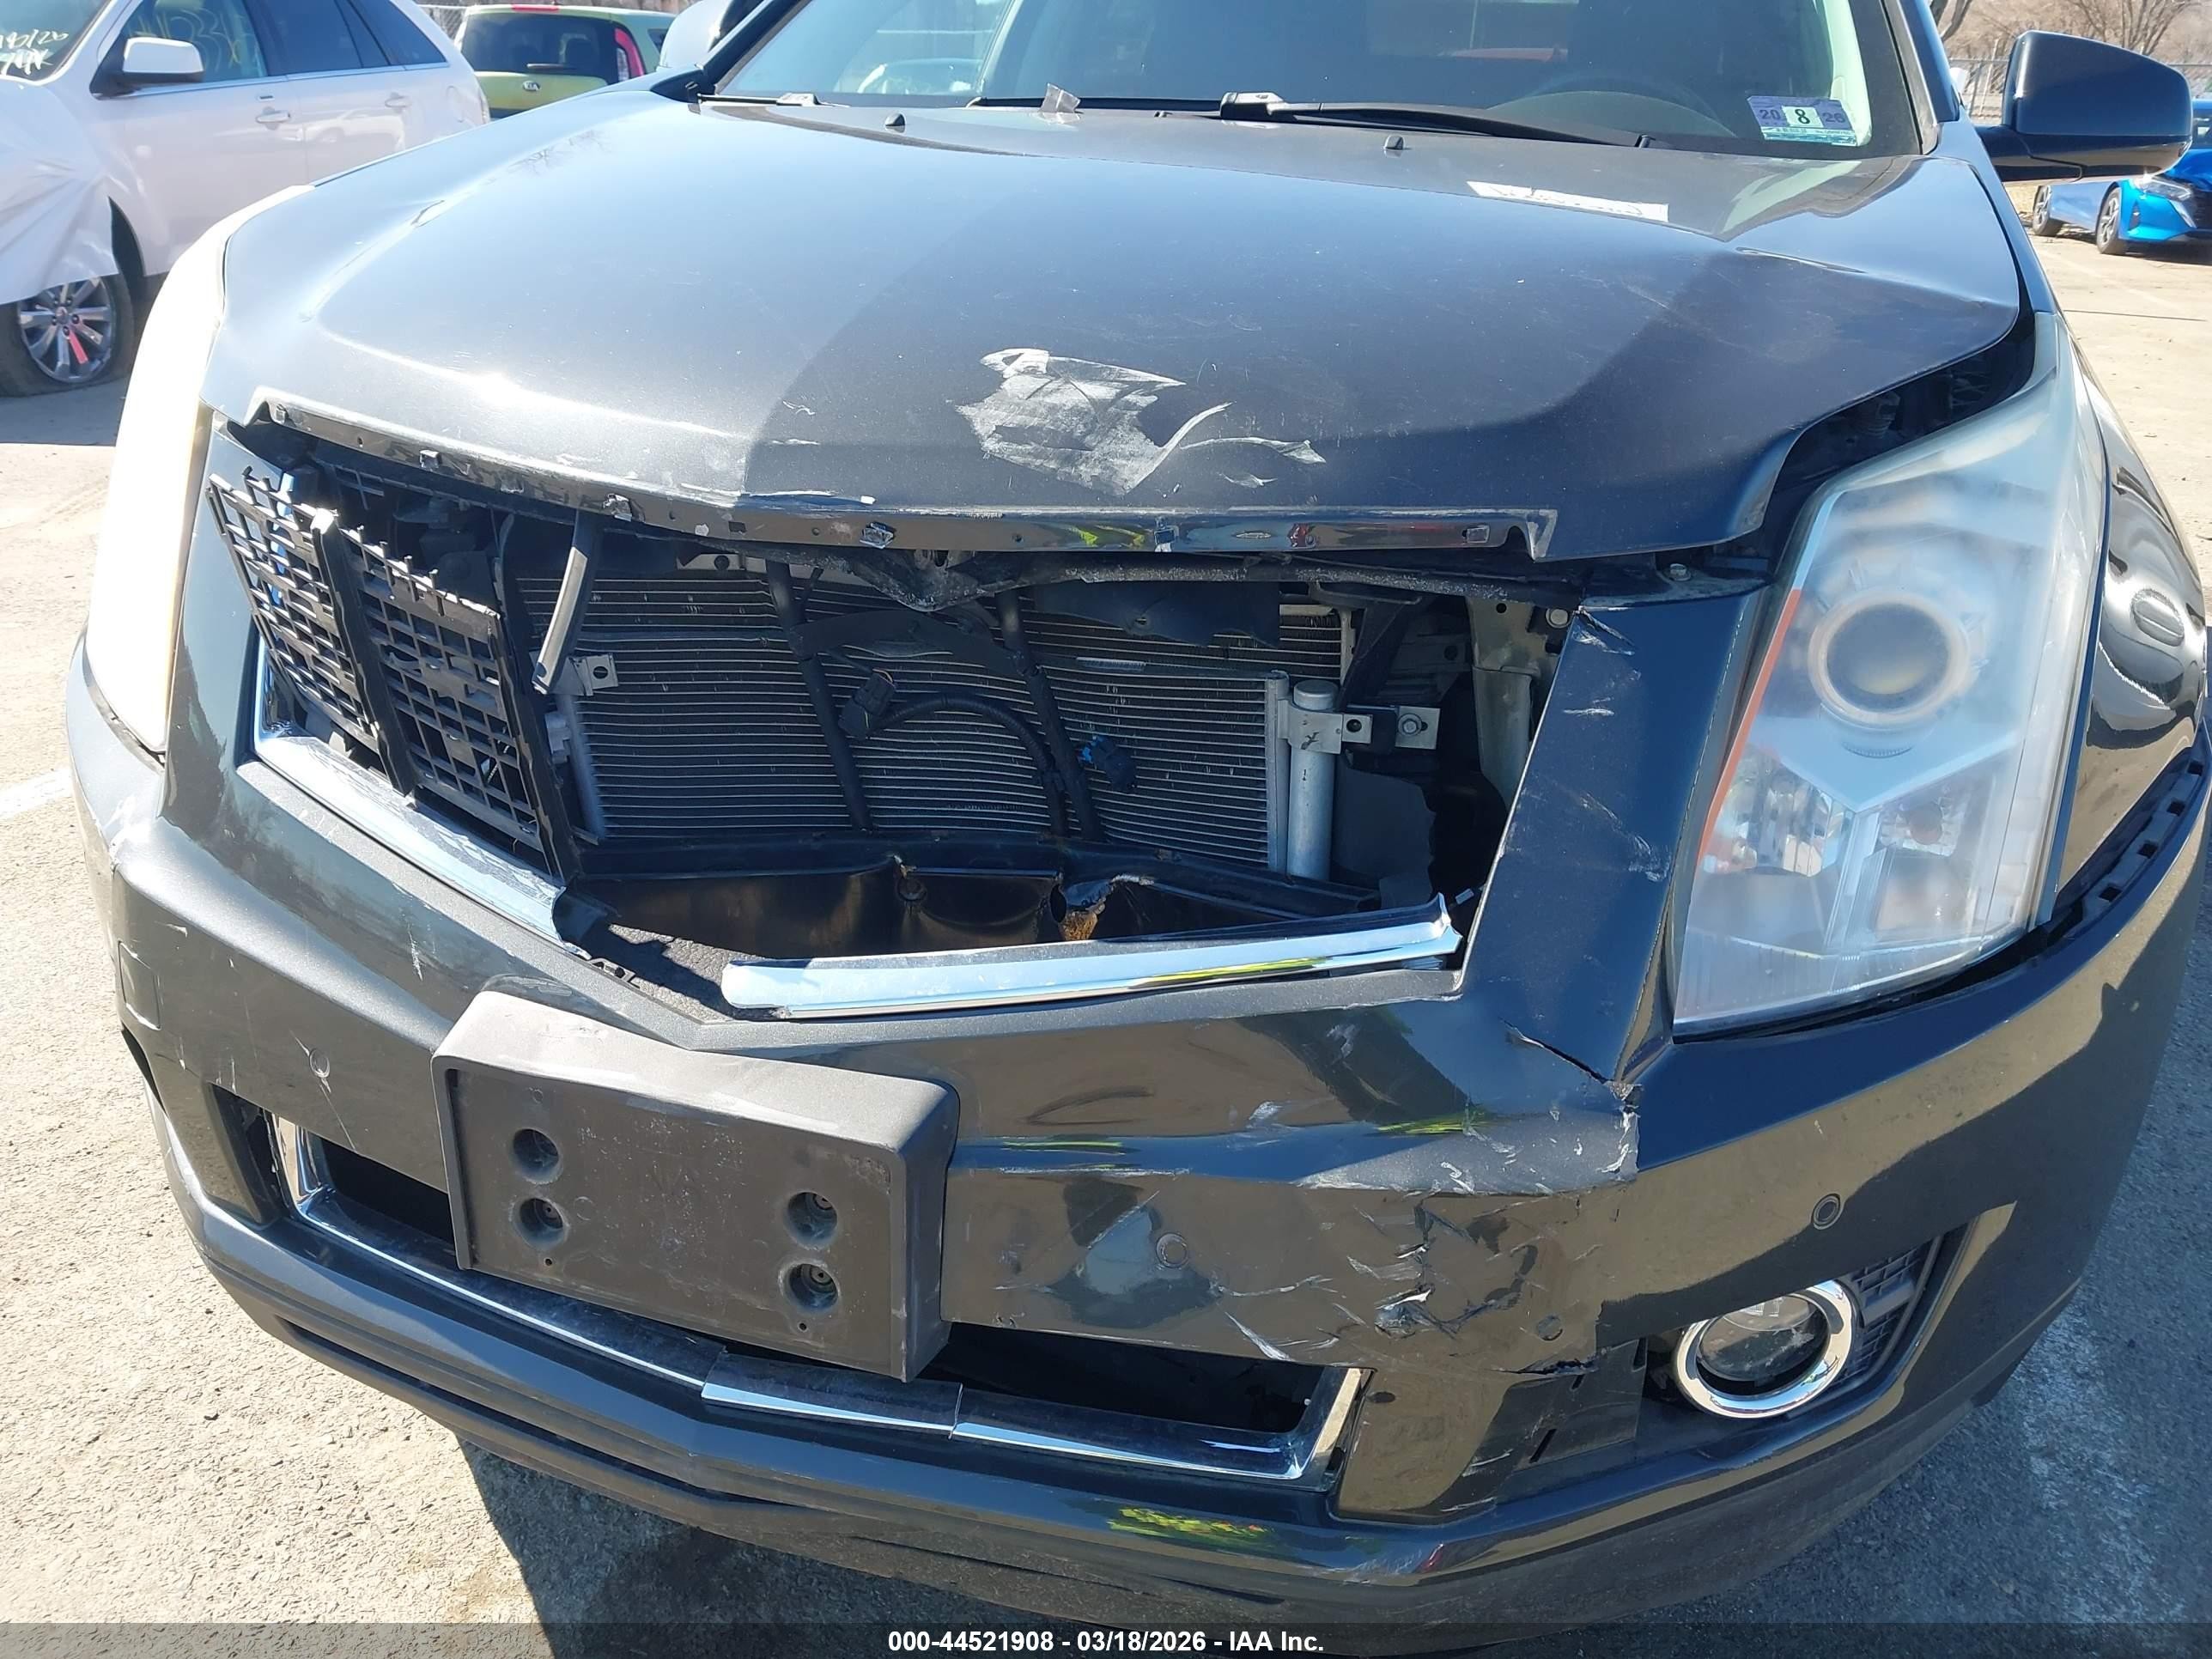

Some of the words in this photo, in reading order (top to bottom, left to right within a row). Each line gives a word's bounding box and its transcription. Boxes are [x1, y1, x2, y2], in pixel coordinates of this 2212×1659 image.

[1759, 109, 1782, 121] 20
[1794, 108, 1811, 125] 8
[1822, 112, 1846, 123] 26
